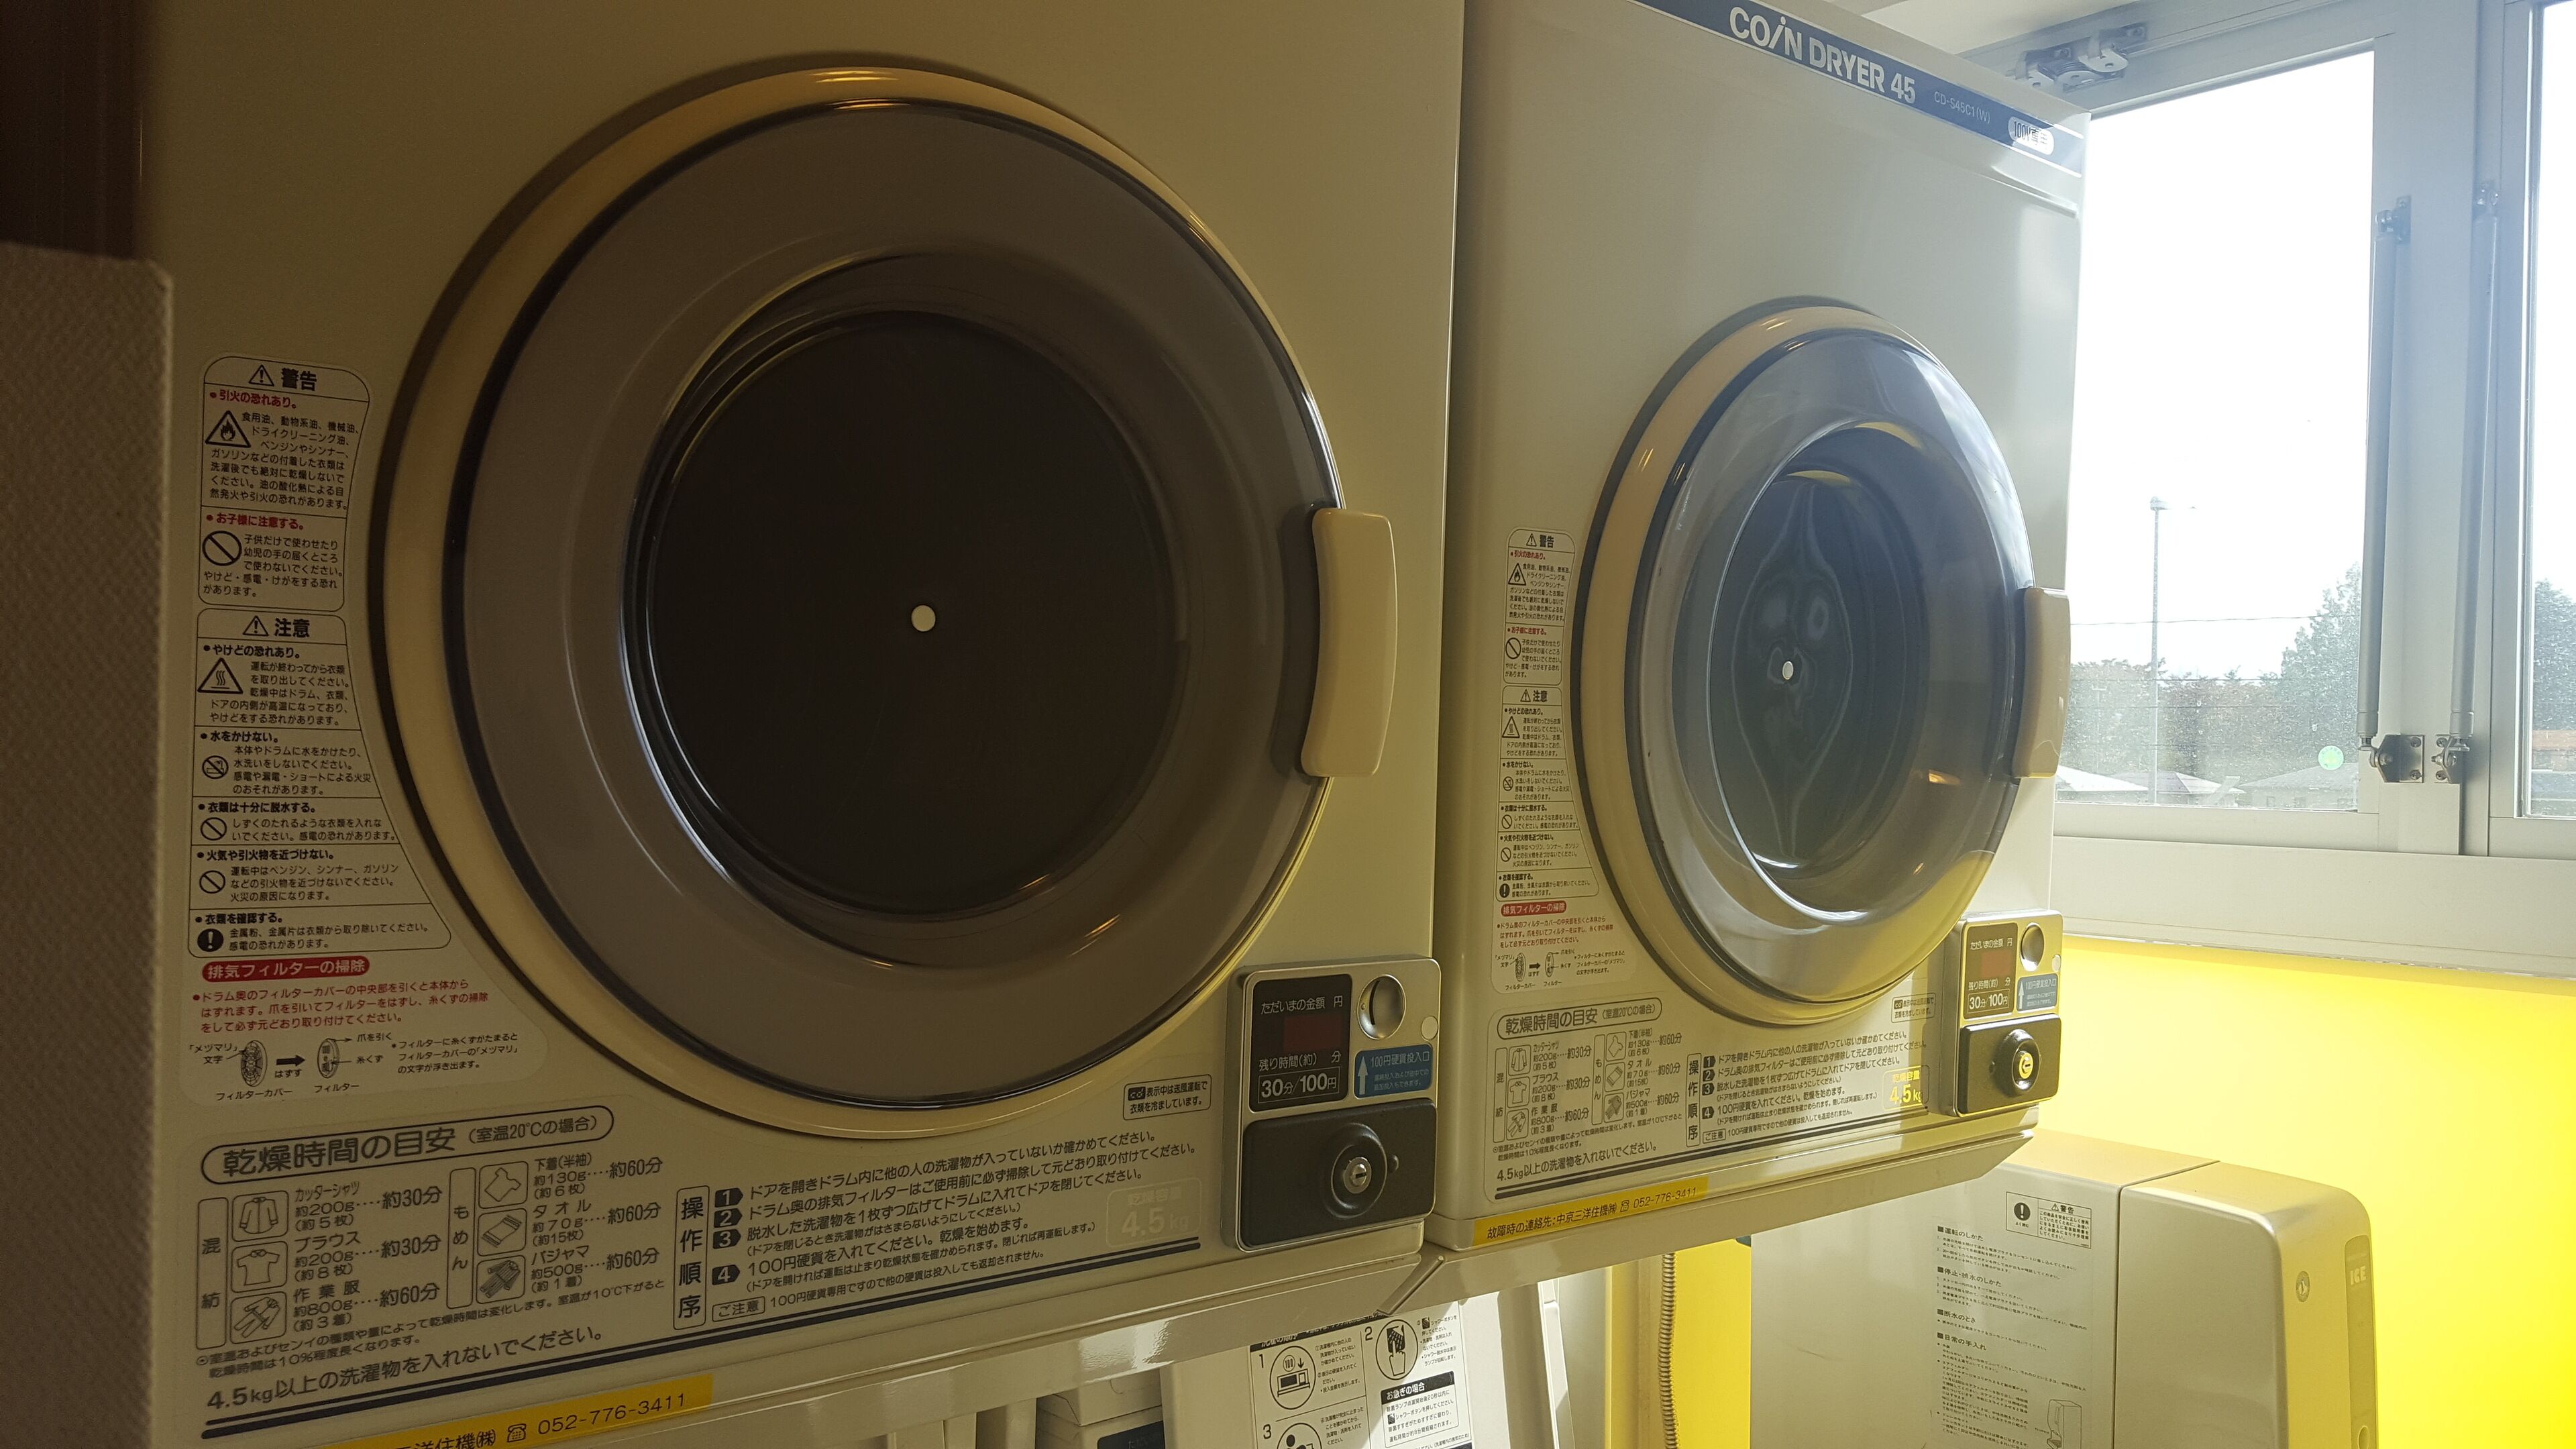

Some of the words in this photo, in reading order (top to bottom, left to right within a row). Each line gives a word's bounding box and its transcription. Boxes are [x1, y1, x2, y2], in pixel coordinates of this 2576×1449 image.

[1809, 36, 1885, 93] DRYER
[1890, 71, 1916, 105] 45
[1934, 91, 1991, 125] CD-S45C1(W)
[281, 368, 317, 391] 警告
[219, 389, 297, 409] 引火の恐れあり。
[241, 412, 359, 434] 食用油、動物系油、機械油、
[252, 427, 350, 445] ドライクリーニング油、
[211, 449, 345, 470] ガソリンなどの付着した衣類は
[210, 462, 345, 484] 洗濯後でも絶対に乾燥しないで
[210, 488, 348, 510] 然発火や引火の恐れがあります。
[216, 512, 304, 531] お子様に注意する。
[244, 534, 338, 551] 子供だけで使わせたり
[1539, 535, 1554, 549] 警告
[244, 547, 338, 564] 幼児の手の届くところ
[244, 561, 343, 578] で使わないでください。
[203, 571, 337, 590] やけど・感電・けがをする恐れ
[203, 585, 258, 598] があります。
[274, 617, 311, 638] 注意
[212, 644, 301, 659] やけどの恐れあり。
[250, 661, 345, 676] 運転が終わってから衣類
[251, 674, 350, 688] を取り出してください。
[250, 687, 348, 701] 乾燥中はドラム、衣類、
[1533, 690, 1548, 702] 注意
[211, 699, 348, 714] ドアの内側が高温になっており、
[209, 712, 339, 726] やけどをする恐れがあります。
[210, 731, 279, 743] 水をかけない。
[234, 745, 361, 757] 本体やドラムに水をかけたり、
[233, 759, 352, 770] 水洗いをしないでください。
[233, 784, 324, 796] のおそれがあります。
[207, 802, 316, 814] 衣類は十分に脱水する。
[233, 818, 382, 829] しずくのたれるような衣類を入れな
[231, 830, 396, 842] いでください。感電の恐れがあります。
[206, 849, 335, 861] 火気や引火物を近づけない。
[230, 876, 394, 890] などの引火物を近づけないでください。
[230, 890, 330, 902] 火災の原因になります。
[205, 912, 282, 924] 衣類を確認する。
[1503, 903, 1566, 915] 排気フィルターの掃除
[229, 922, 429, 938] 金属粉、金属片は衣類から取り除いてください。
[228, 940, 329, 951] 感電の恐れがあります。
[2007, 937, 2013, 947] 円
[207, 959, 366, 979] 排気フィルターの掃除
[202, 979, 469, 1002] ドラム奥のフィルターカバーの中央部を引くと本体から
[1505, 982, 1536, 991] フィルターカバー
[2004, 977, 2010, 986] 分
[1261, 996, 1326, 1015] ただいまの金額
[1334, 995, 1343, 1008] 円
[1969, 993, 2008, 1010] 30分/100円
[201, 1012, 402, 1033] をして必ず元どおり取り付けてください。
[1505, 1008, 1598, 1036] 乾燥時間の目安
[357, 1031, 392, 1043] 爪を引く
[1659, 1032, 1682, 1046] 約60分
[203, 1055, 224, 1065] 文字
[356, 1055, 384, 1065] 糸くず
[1371, 1051, 1430, 1069] 100円硬貨投入口
[1567, 1045, 1592, 1059] 約30分
[397, 1060, 480, 1075] の文字が浮き出ます。
[1259, 1053, 1318, 1072] 残り時間(約)
[1331, 1051, 1342, 1064] 分
[1627, 1058, 1652, 1070] タオル
[1658, 1062, 1681, 1076] 約60分
[274, 1068, 302, 1079] はずす
[1532, 1071, 1560, 1085] ブラウス
[1594, 1059, 1603, 1101] もめん
[314, 1083, 360, 1094] フィルター
[1146, 1081, 1208, 1097] 表示中は送風運転で
[1261, 1073, 1337, 1098] 30分/100円
[1566, 1076, 1591, 1091] 約30分
[216, 1087, 293, 1102] フィルターカバー
[1657, 1092, 1680, 1106] 約60分
[1687, 1059, 1700, 1141] 操作順序
[1130, 1095, 1202, 1114] 衣類を冷ましています。
[1564, 1108, 1590, 1122] 約60分
[223, 1127, 456, 1177] 乾燥時間の目安
[722, 1190, 731, 1206] 1
[750, 1130, 1155, 1201] ドアを開きドラム内に他の人の洗濯物が入っていないか確かめてください。
[1497, 1142, 1658, 1182] 4.5kg以上の洗濯物を入れないでください。
[533, 1171, 588, 1187] 約130g
[608, 1156, 663, 1180] 約60分
[294, 1180, 361, 1203] カッターシャツ
[718, 1210, 733, 1226] 2
[749, 1142, 1195, 1221] ドラム奥の排気フィルターはご使用前に必ず掃除して元どおり取り付けてください。
[295, 1202, 355, 1218] 約200g
[381, 1185, 443, 1210] 約30分
[1633, 1187, 1697, 1209] 052-776-3411
[533, 1199, 592, 1220] タオル
[607, 1201, 662, 1226] 約60分
[718, 1230, 731, 1248] 3
[747, 1168, 1143, 1242] 脱水した洗濯物を1枚ずつ広げてドラムに入れてドアを閉じてください。
[747, 1201, 1023, 1257] (ドアを閉じるとき洗濯物がはさまらないようにしてください。)
[1122, 1208, 1165, 1238] 4.5
[294, 1231, 362, 1253] ブラウス
[451, 1205, 469, 1271] もめん
[1945, 1227, 1984, 1242] 運転のしかた
[294, 1252, 355, 1269] 約200g
[380, 1234, 442, 1259] 約30分
[531, 1244, 590, 1267] パジャマ
[678, 1197, 704, 1320] 操作順序
[717, 1265, 731, 1283] 4
[747, 1217, 1029, 1277] 100円硬貨を入れてください。乾燥を始めます。
[202, 1236, 222, 1309] 混紡
[531, 1264, 584, 1281] 約500g
[606, 1246, 661, 1271] 約60分
[718, 1301, 760, 1318] ご注意
[770, 1250, 1044, 1309] 100円硬貨専用ですので他の硬貨は投入しても返却されません。
[2350, 1265, 2367, 1285] ICE
[292, 1279, 361, 1305] 作業服
[293, 1301, 354, 1319] 約800g
[379, 1282, 441, 1308] 約60分
[1364, 1326, 1373, 1341] 2
[207, 1326, 602, 1410] 4.5kg以上の洗濯物を入れないでください。
[1386, 1382, 1425, 1401] お急ぎの場合
[537, 1393, 686, 1435] 052-776-3411
[1263, 1424, 1273, 1440] 3
